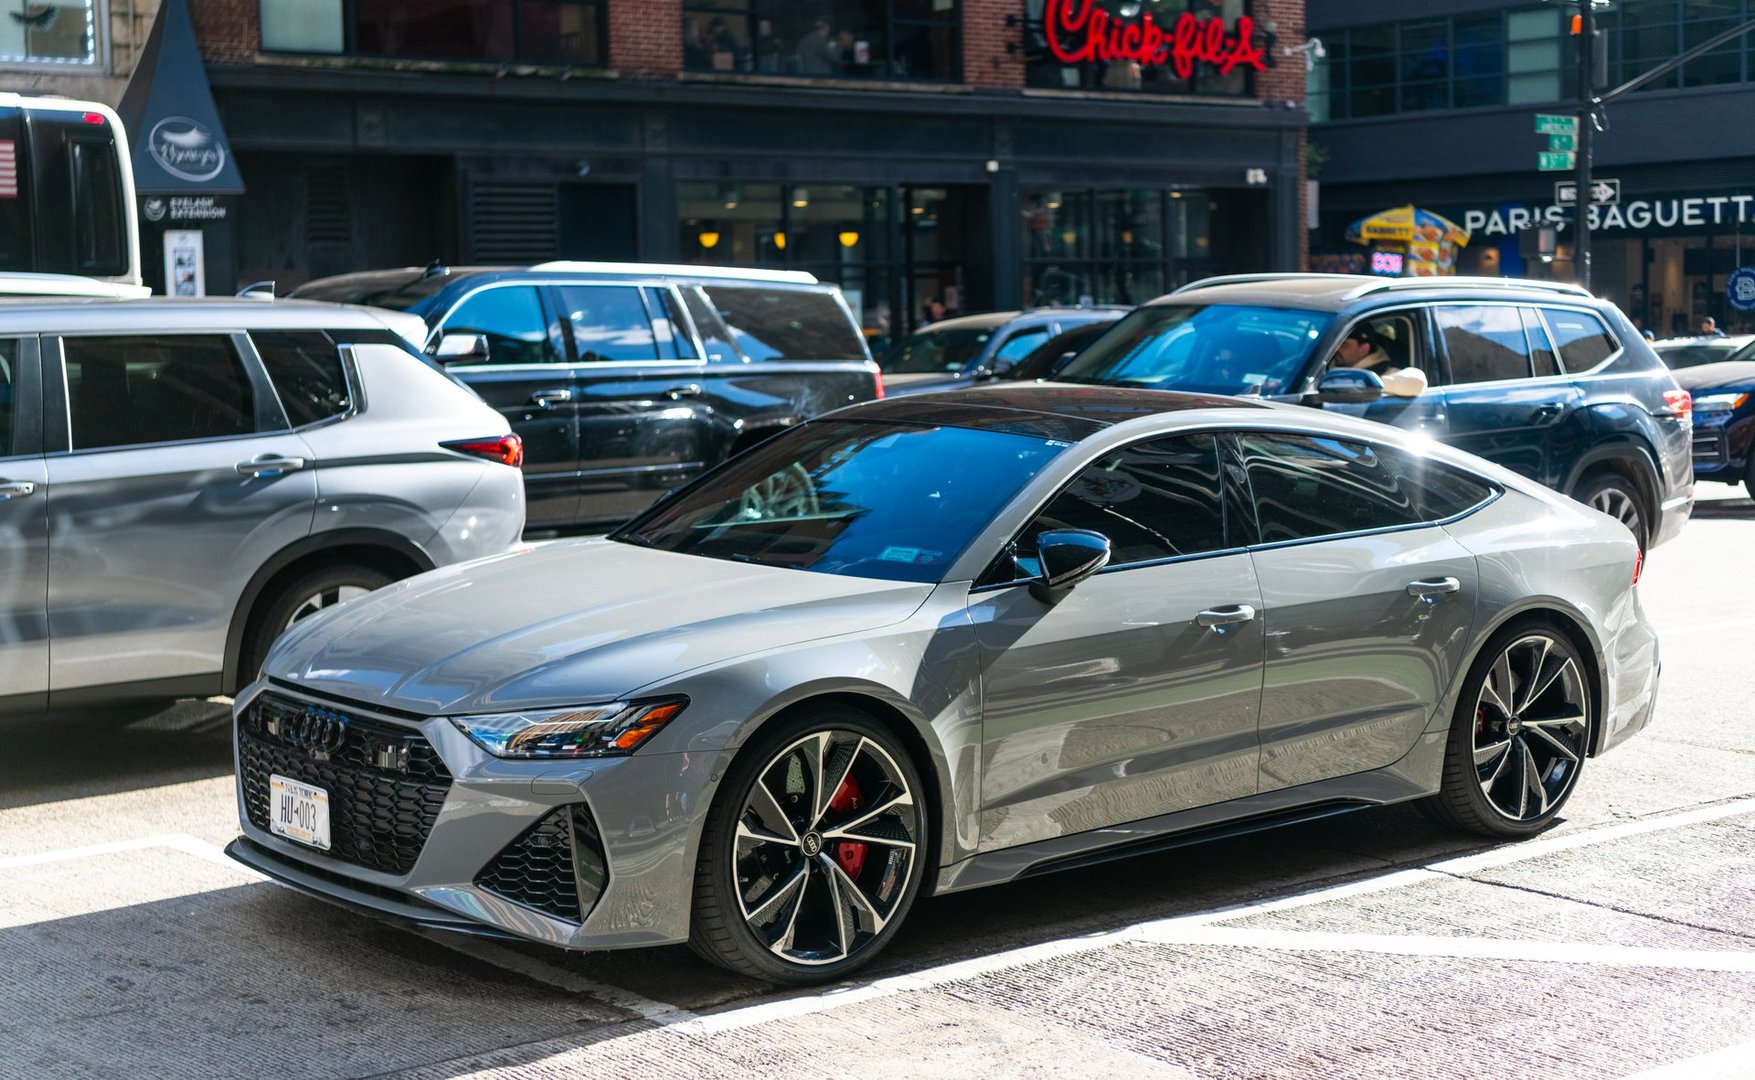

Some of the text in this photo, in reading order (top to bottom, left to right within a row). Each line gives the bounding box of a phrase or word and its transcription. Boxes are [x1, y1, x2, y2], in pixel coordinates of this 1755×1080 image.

[1045, 0, 1267, 79] Chick-fil-A
[169, 197, 214, 208] EYELASH
[170, 207, 226, 219] EXTENSION
[1465, 195, 1755, 236] PARIS BAGUETT
